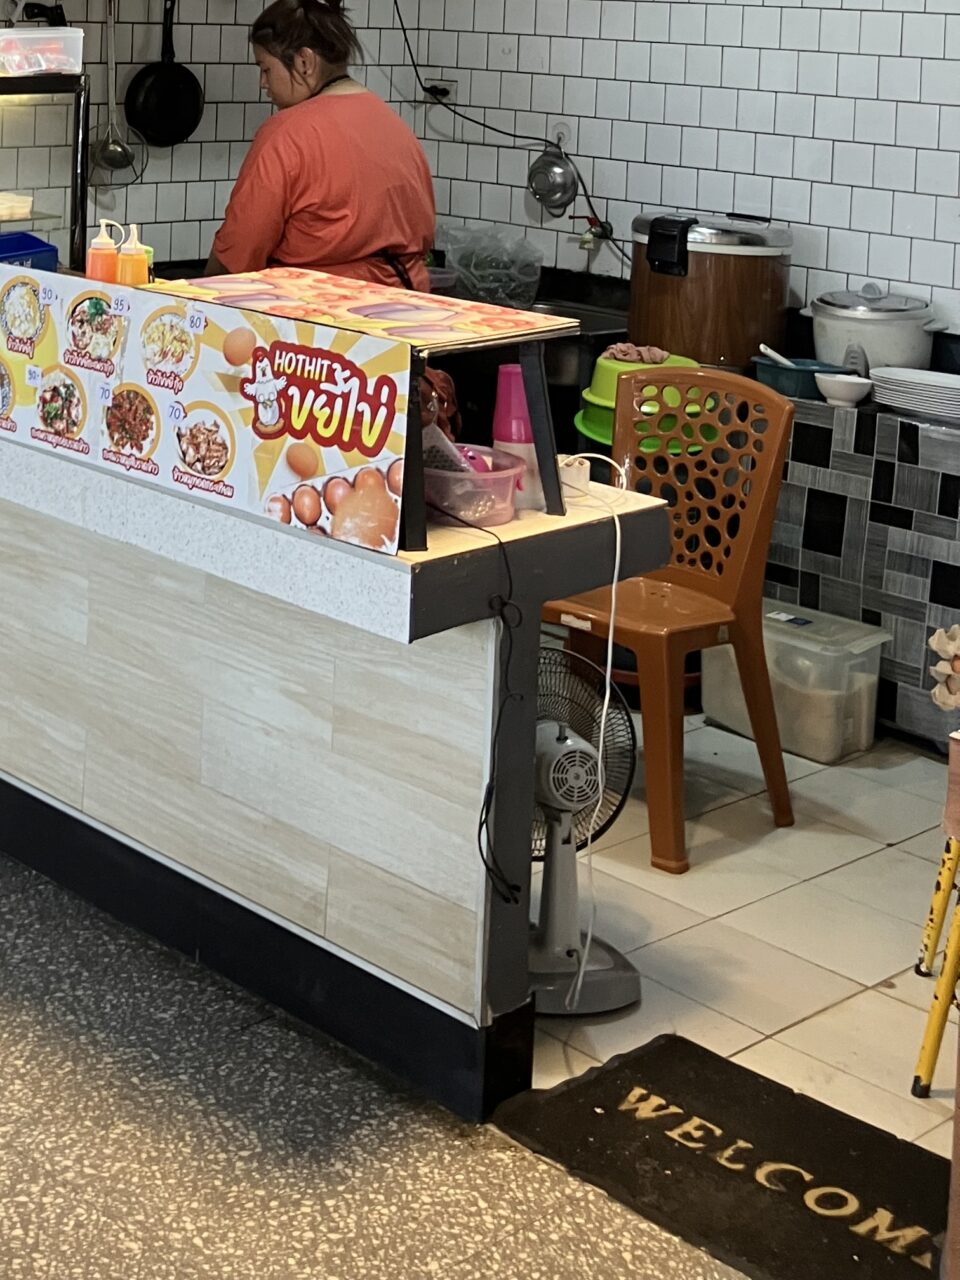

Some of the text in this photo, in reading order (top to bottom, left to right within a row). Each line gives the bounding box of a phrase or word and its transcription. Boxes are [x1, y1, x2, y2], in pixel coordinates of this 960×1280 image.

[273, 349, 332, 381] HOTHIT
[100, 387, 111, 401] 70
[288, 363, 388, 448] ขยี้ไข่
[168, 405, 182, 420] 70
[617, 1085, 933, 1271] WELCOM
